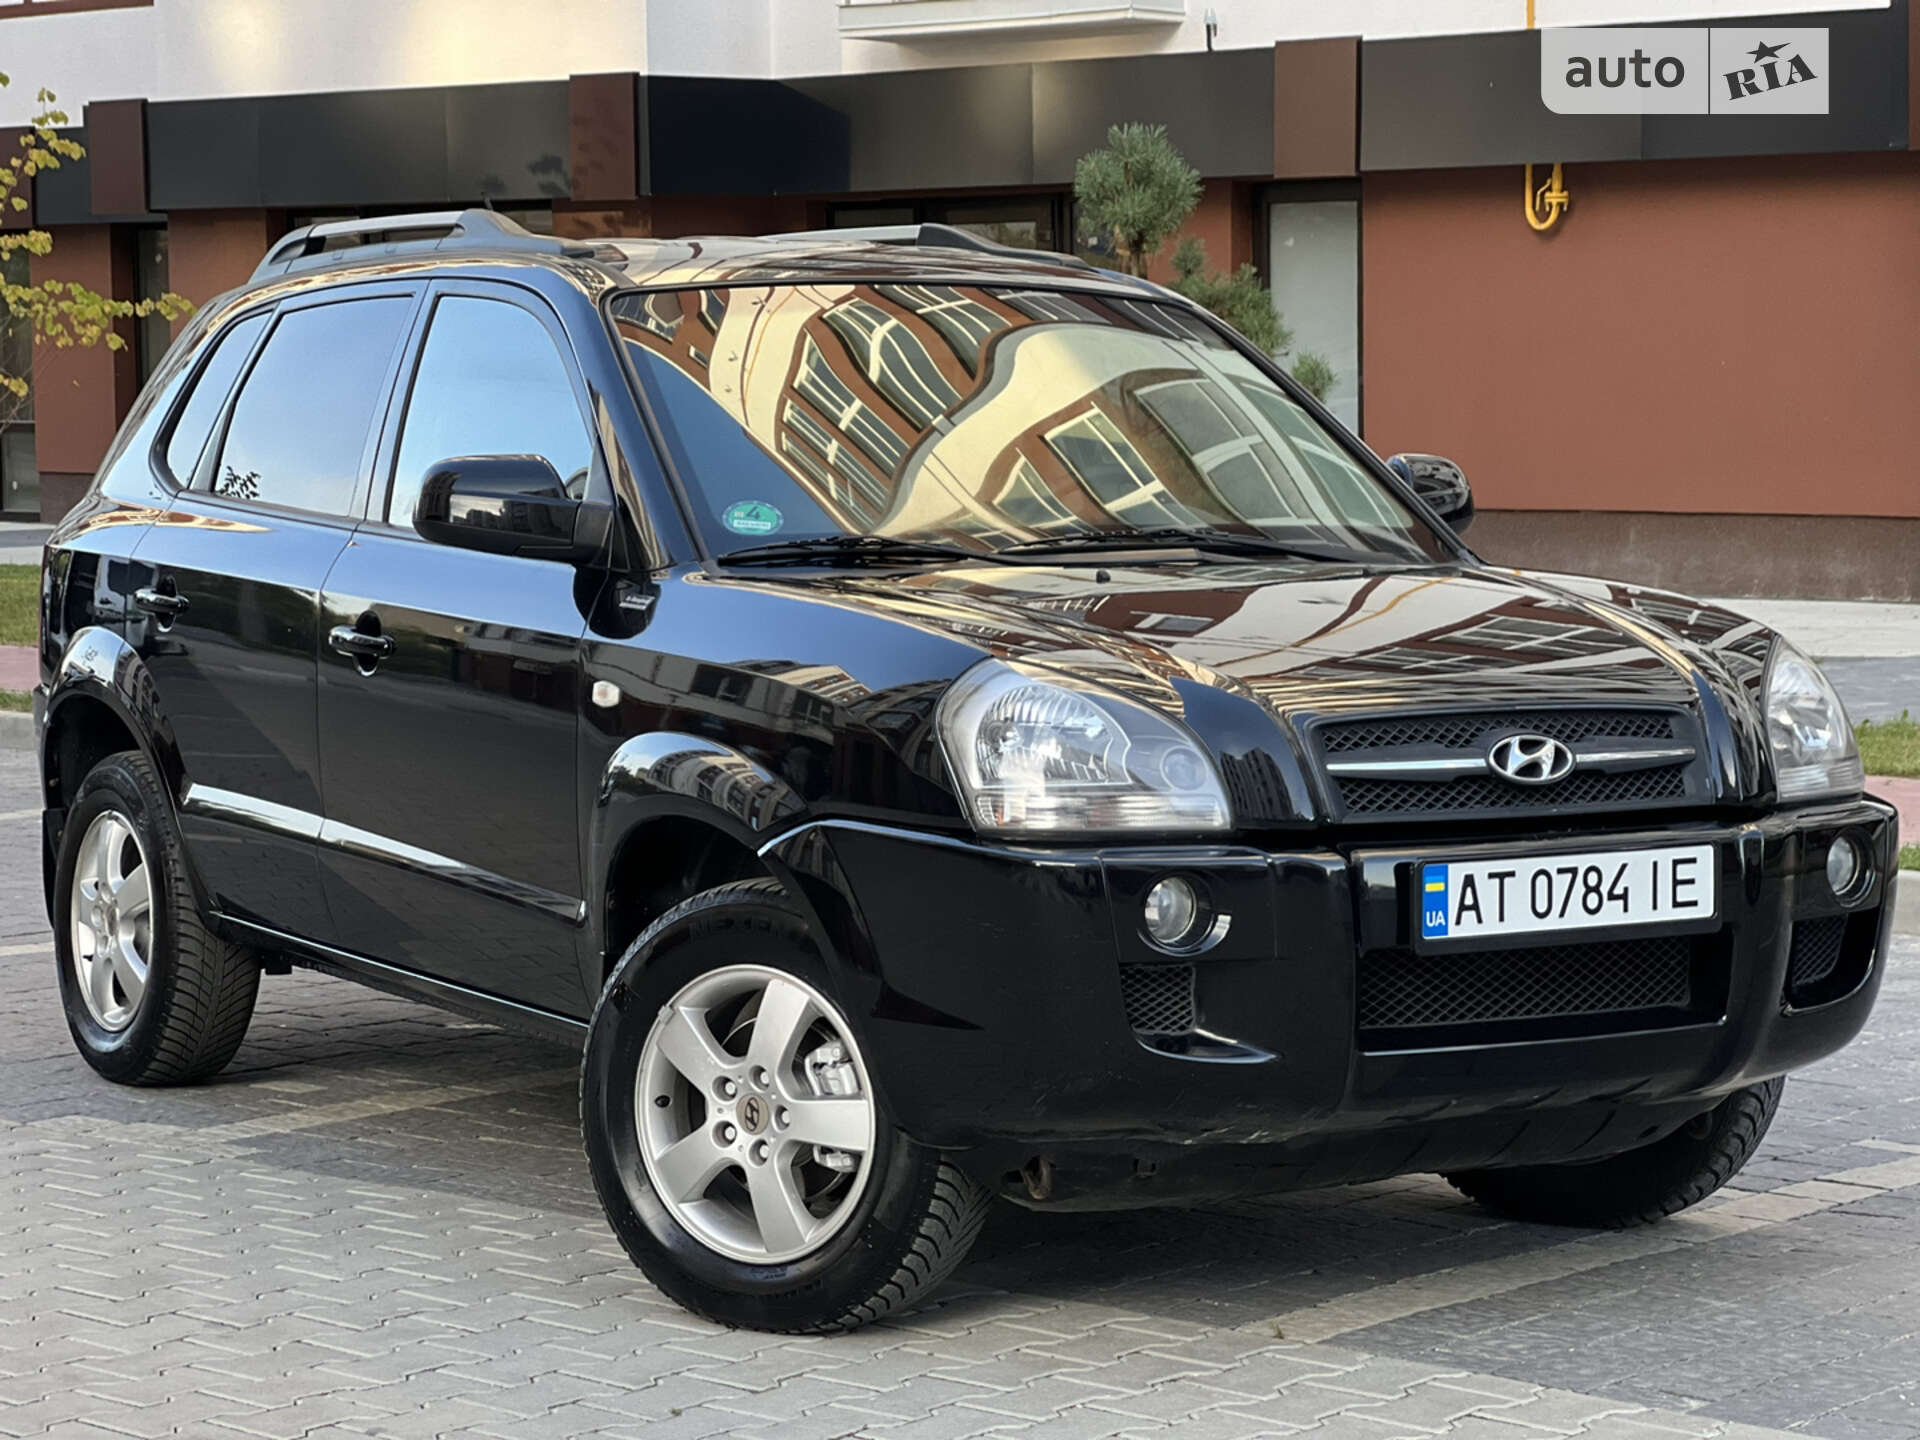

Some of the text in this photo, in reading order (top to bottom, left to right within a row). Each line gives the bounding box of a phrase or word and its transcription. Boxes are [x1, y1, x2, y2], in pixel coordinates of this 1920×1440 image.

[1454, 857, 1699, 926] AT 0784 IE
[1426, 911, 1446, 928] UA
